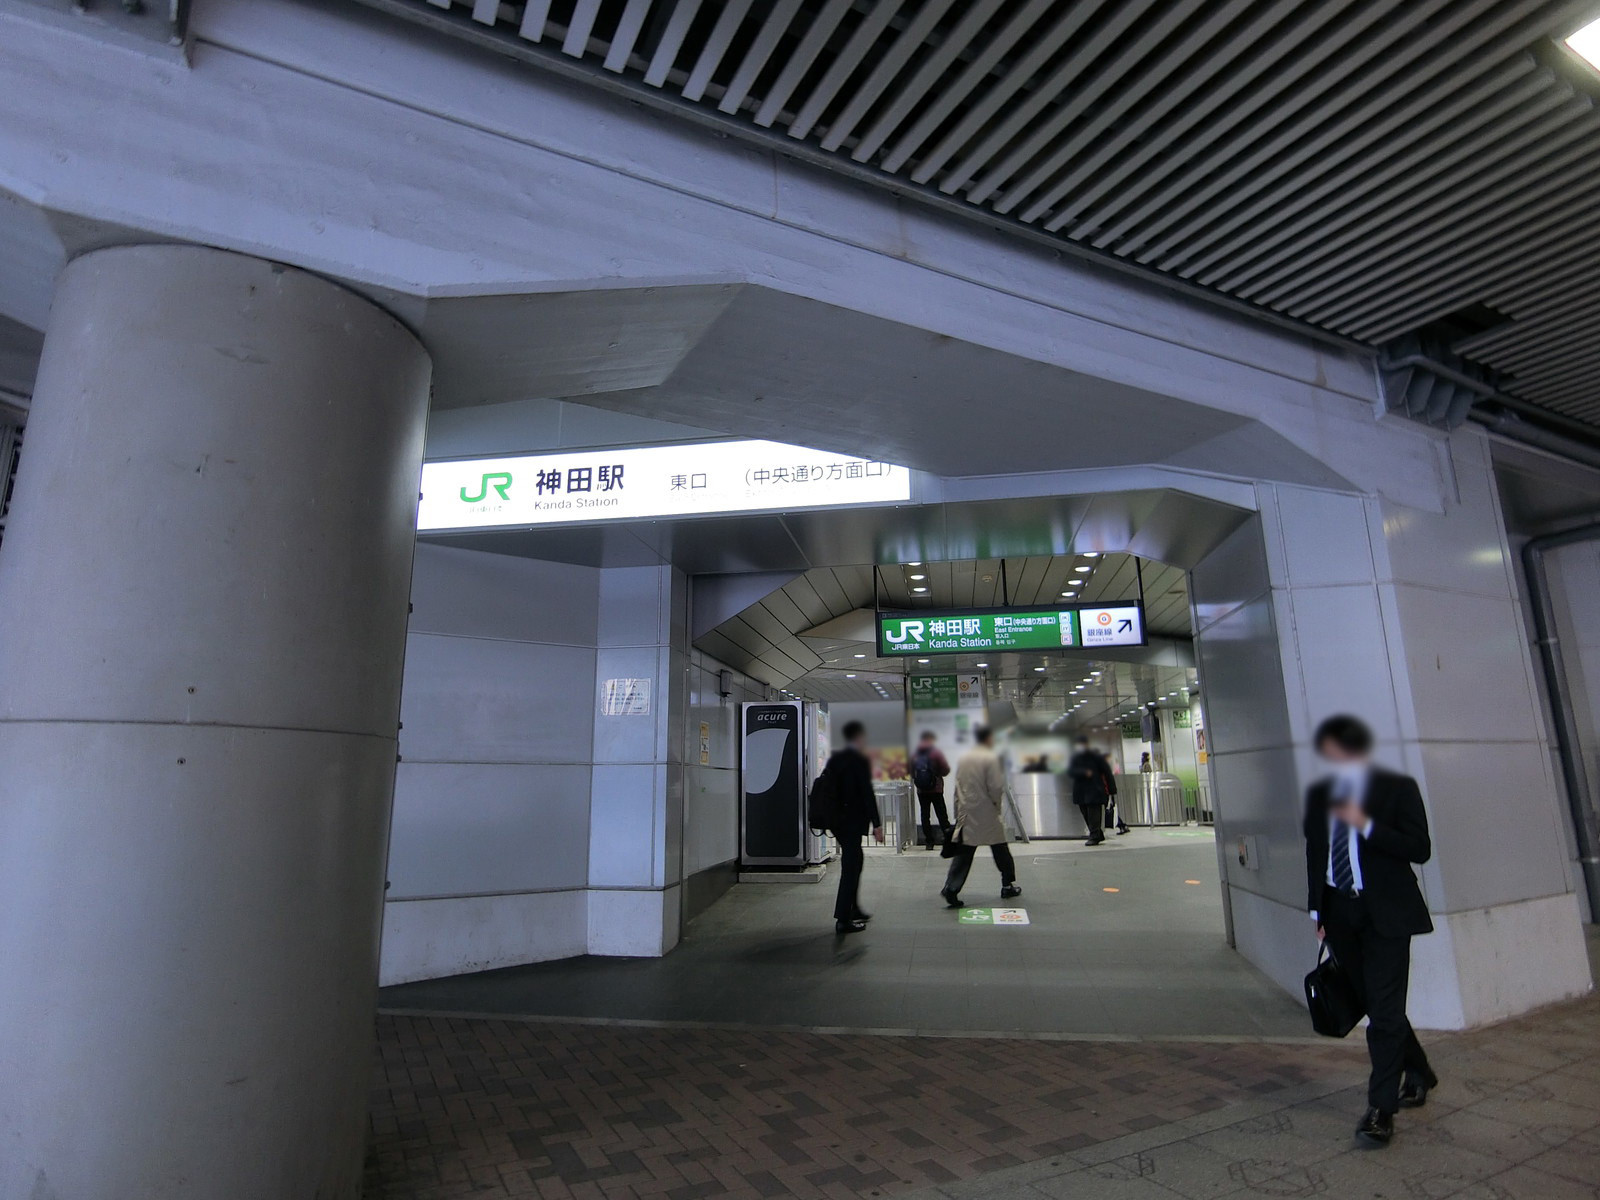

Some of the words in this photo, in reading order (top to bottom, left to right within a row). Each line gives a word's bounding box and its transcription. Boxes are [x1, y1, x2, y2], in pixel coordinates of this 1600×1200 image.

[460, 472, 512, 502] JR
[536, 464, 624, 496] 神田駅
[670, 473, 707, 491] 東口
[534, 500, 572, 511] Kanda
[576, 496, 618, 508] Station
[886, 621, 925, 643] JR
[929, 619, 981, 637] 神田駅
[929, 639, 958, 649] Kanda
[960, 638, 992, 648] Station
[913, 678, 932, 688] JR
